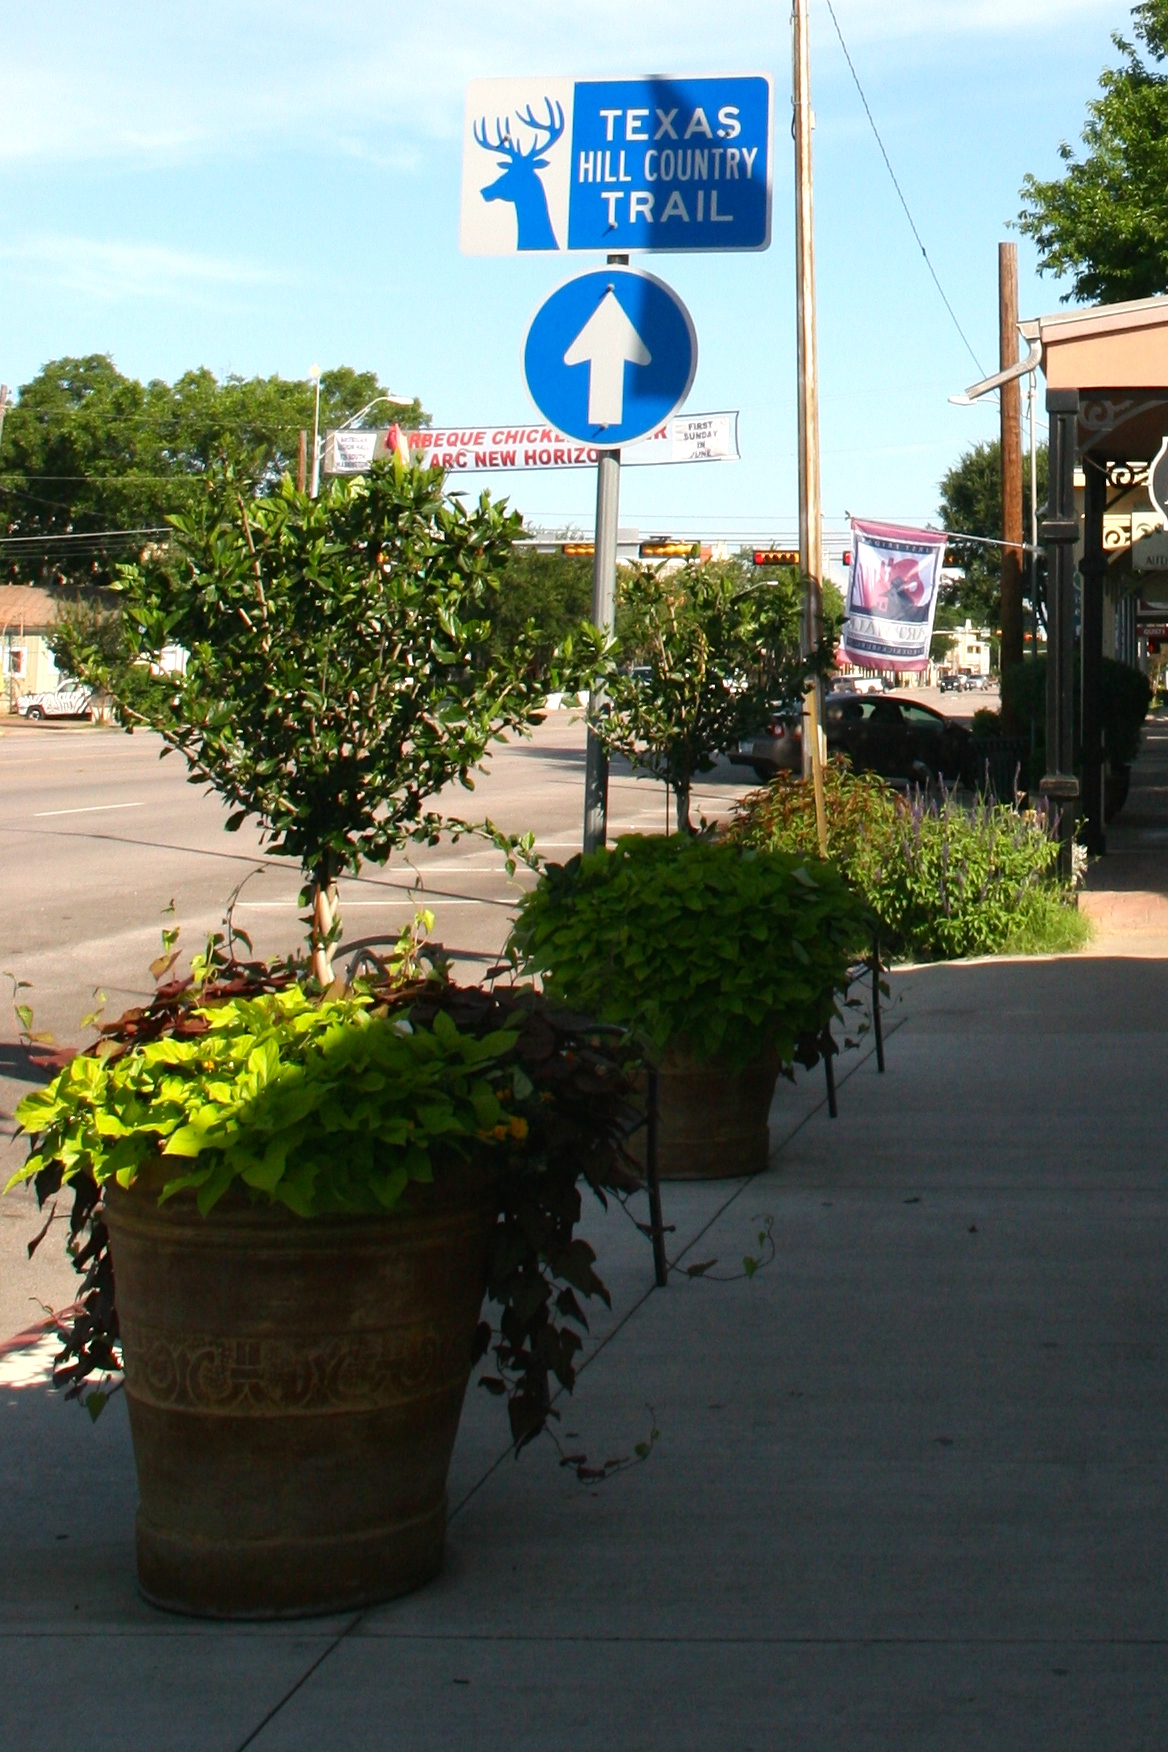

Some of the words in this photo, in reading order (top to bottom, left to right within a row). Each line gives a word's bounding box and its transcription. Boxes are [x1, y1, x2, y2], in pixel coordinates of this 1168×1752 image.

[600, 106, 742, 142] TEXAS
[578, 150, 632, 183] HILL
[644, 147, 758, 182] COUNTRY
[601, 190, 734, 223] TRAIL
[683, 429, 719, 441] SUNDAY
[687, 420, 713, 431] FIRST
[408, 430, 485, 449] RBEQUE
[492, 426, 567, 447] CHICKE
[696, 440, 706, 449] IN
[474, 448, 520, 467] NEW
[525, 445, 600, 466] HORIZO
